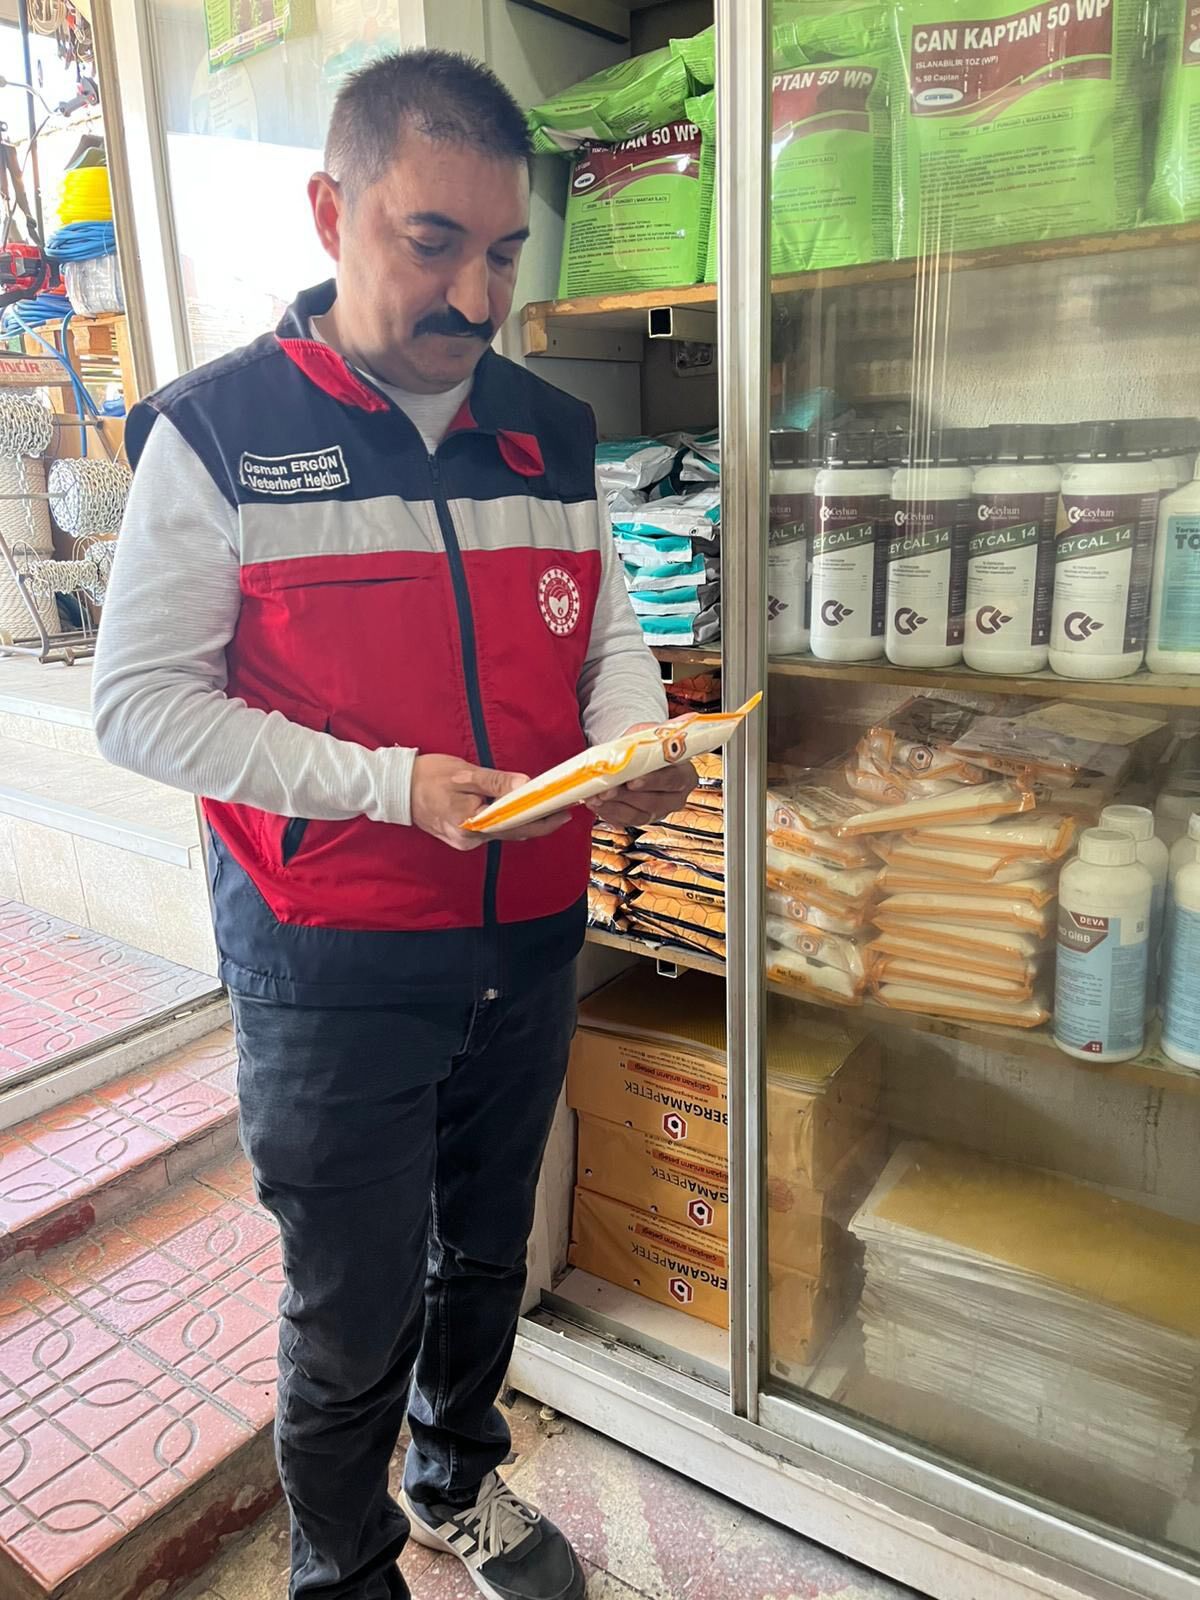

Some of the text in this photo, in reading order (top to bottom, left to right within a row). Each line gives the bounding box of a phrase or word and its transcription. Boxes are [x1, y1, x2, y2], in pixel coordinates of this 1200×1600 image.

[914, 0, 1111, 53] CAN KAPTAN 50 WP
[817, 70, 840, 86] 50
[843, 70, 873, 89] WP
[651, 128, 671, 146] 50
[674, 124, 699, 144] WP
[244, 455, 338, 476] Osman ERGÜN
[1081, 508, 1115, 518] Ceyhun
[793, 522, 805, 534] 14
[828, 531, 855, 545] CAL
[860, 526, 873, 538] 14
[986, 532, 1016, 546] CAL
[1021, 526, 1036, 539] 14
[903, 537, 930, 551] CAL
[935, 531, 949, 543] 14
[1077, 535, 1110, 550] CAL
[1115, 529, 1131, 543] 14
[1080, 917, 1104, 926] DEVA
[624, 1079, 728, 1126] BERGAMAPETEK
[631, 1242, 728, 1291] ERGAMAPETEK
